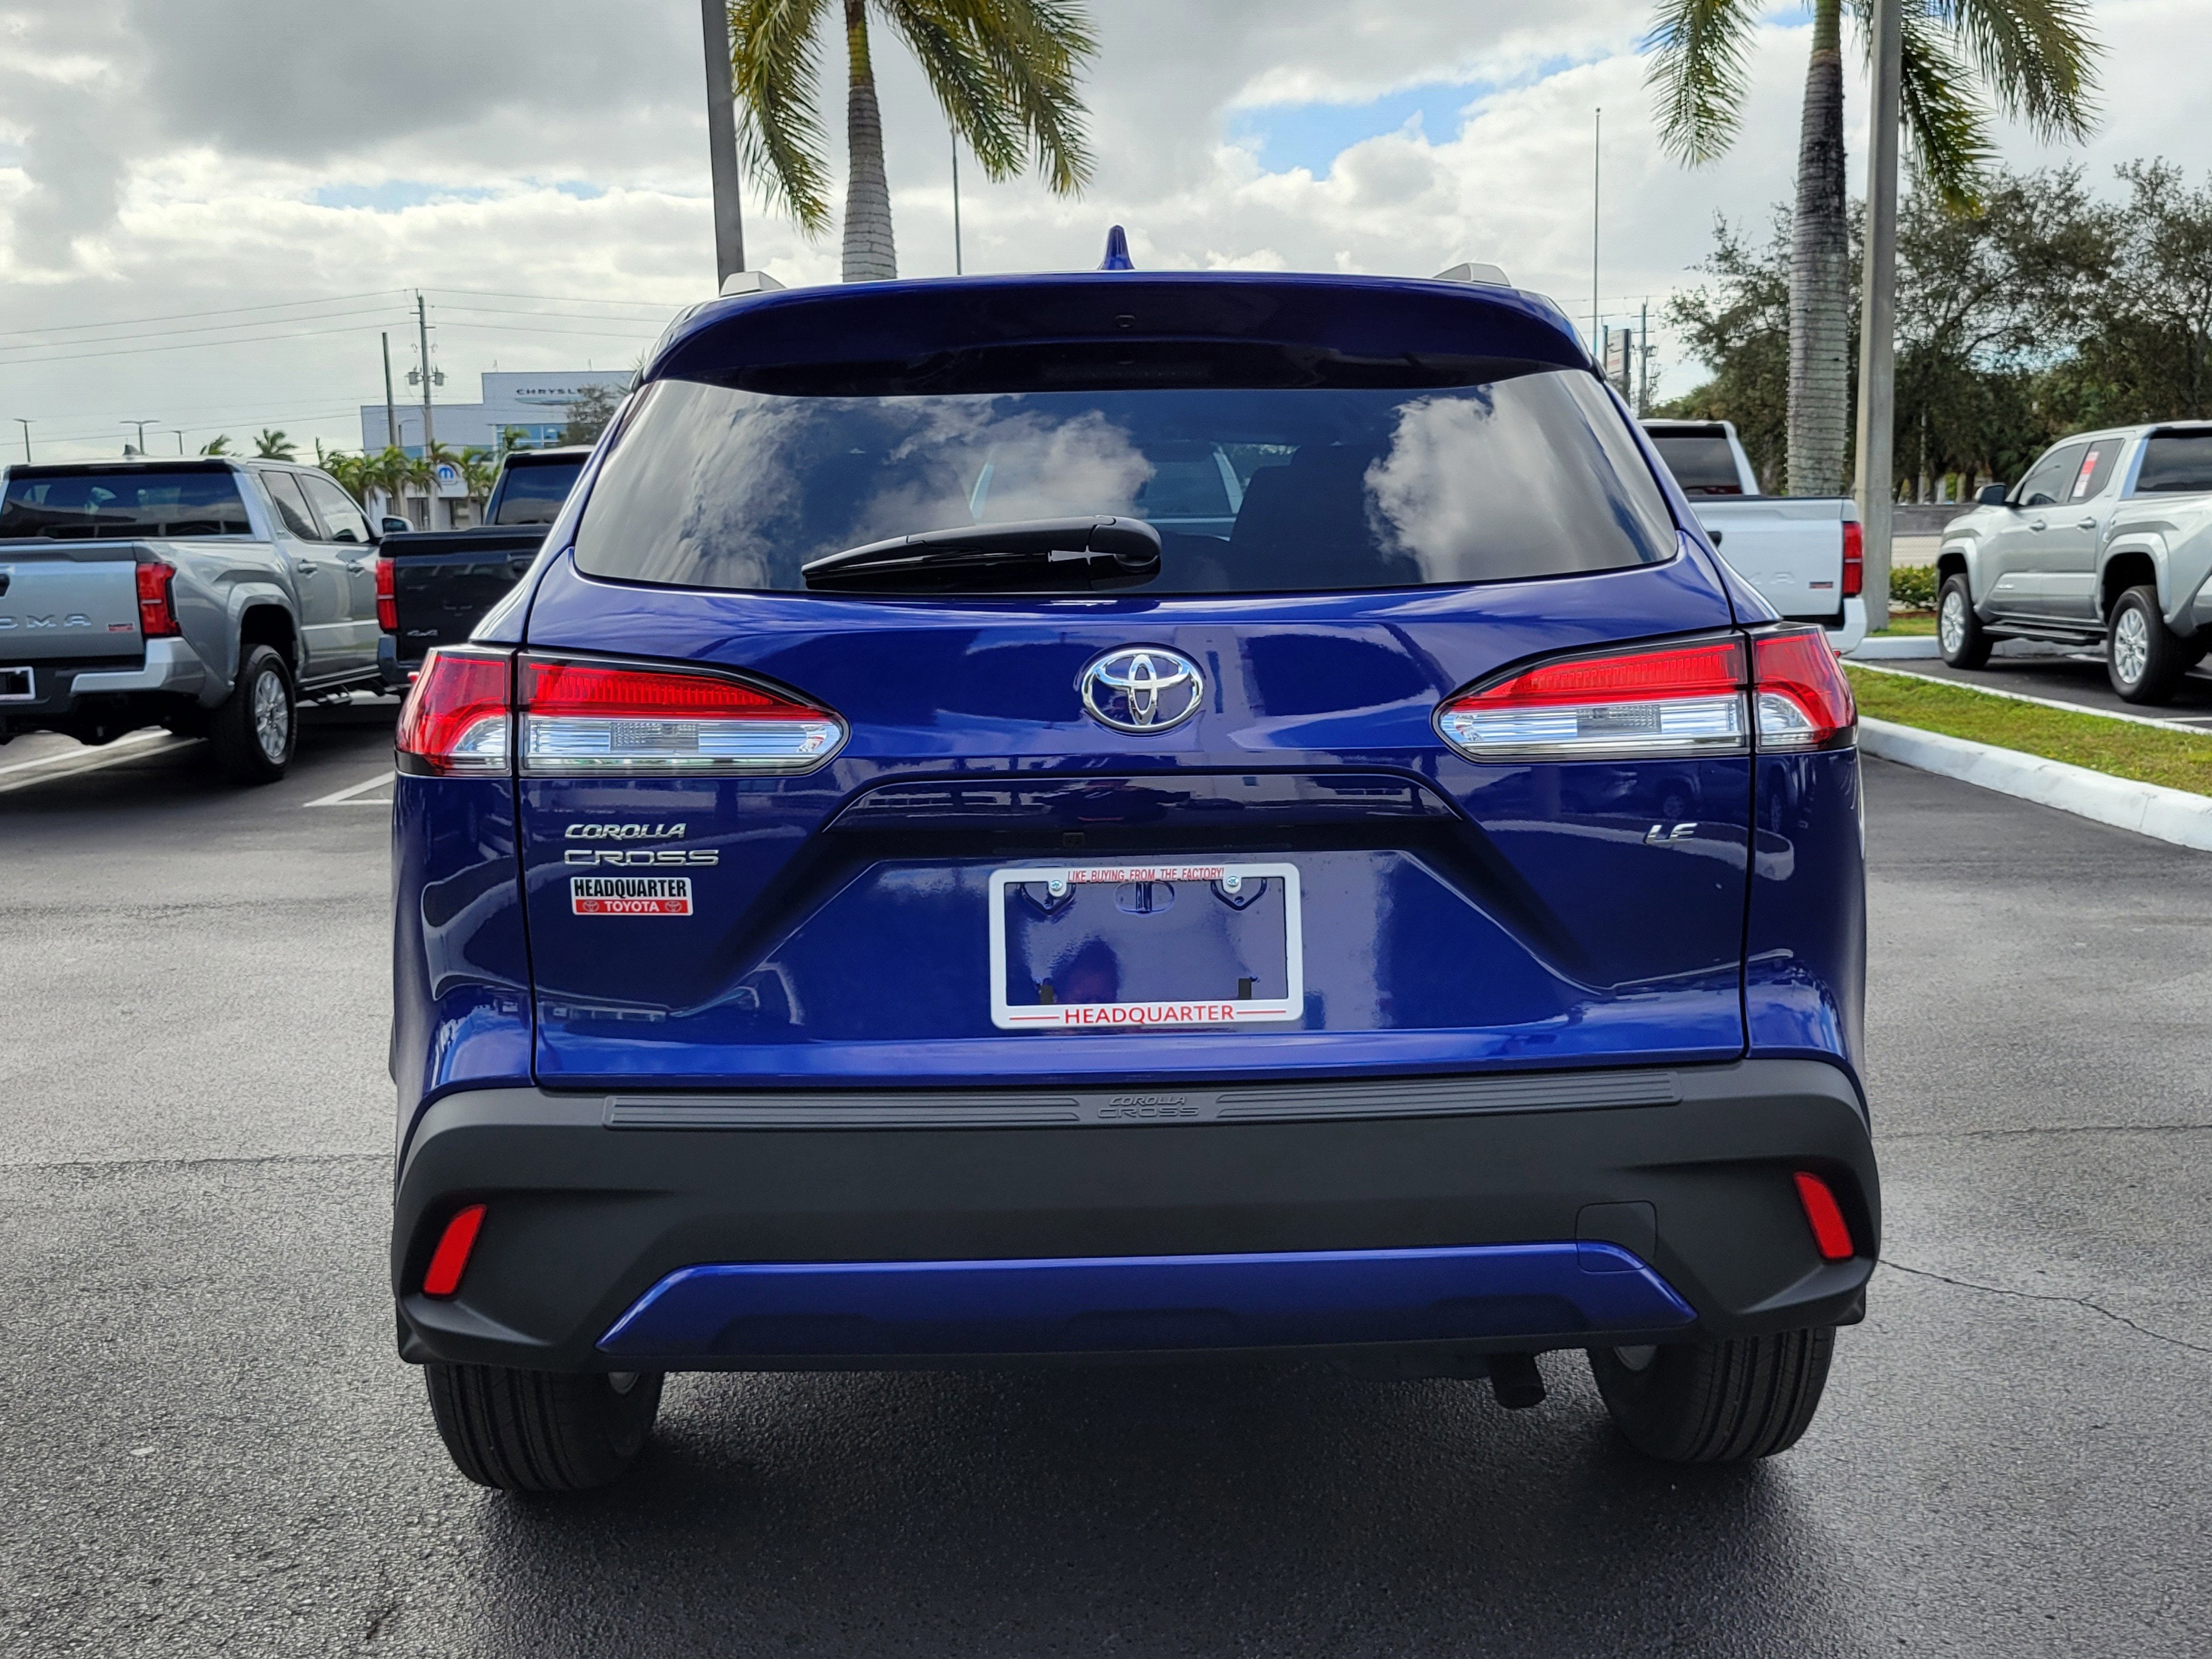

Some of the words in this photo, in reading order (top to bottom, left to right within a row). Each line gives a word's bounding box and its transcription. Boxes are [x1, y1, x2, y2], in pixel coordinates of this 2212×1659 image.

[565, 823, 686, 840] COROLLA
[1645, 822, 1699, 848] LE
[564, 849, 719, 867] CROSS
[1067, 870, 1087, 883] LIKE
[1091, 869, 1125, 882] BUYING
[1129, 868, 1155, 881] FROM
[1160, 868, 1177, 880] THE
[1182, 867, 1225, 880] FACTORY!
[573, 878, 687, 898] HEADQUARTER
[604, 900, 659, 912] TOYOTA
[1064, 1004, 1235, 1025] HEADQUARTER
[1108, 1096, 1186, 1107] COROLLA
[1098, 1106, 1199, 1118] CROSS
